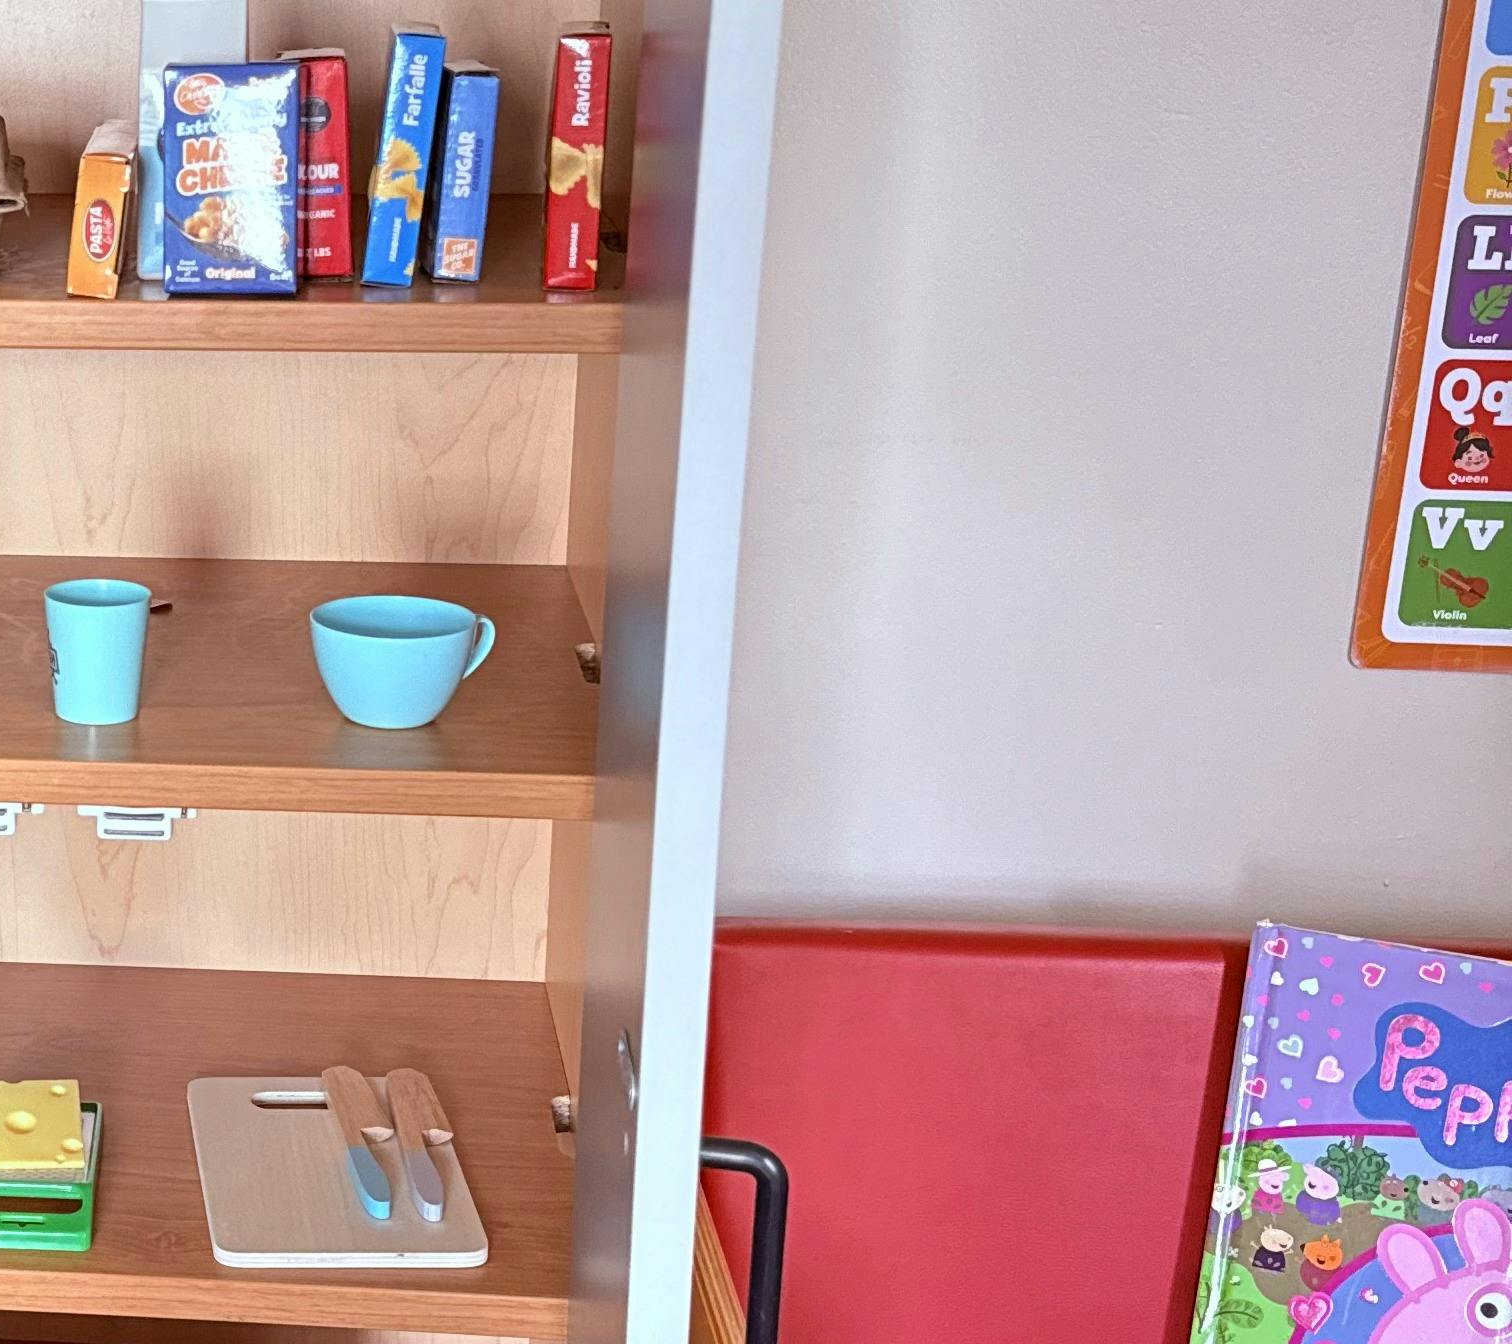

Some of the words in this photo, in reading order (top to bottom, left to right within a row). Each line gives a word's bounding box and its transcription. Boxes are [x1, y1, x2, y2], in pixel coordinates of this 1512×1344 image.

[402, 52, 428, 127] Farfalle
[571, 59, 593, 127] Ravioli
[453, 130, 476, 199] SUGAR
[89, 206, 103, 254] PASTA
[205, 266, 256, 281] Original
[1468, 333, 1500, 344] Leaf
[1448, 472, 1489, 486] Queen
[1422, 506, 1504, 551] Vv
[1433, 609, 1468, 621] Violin
